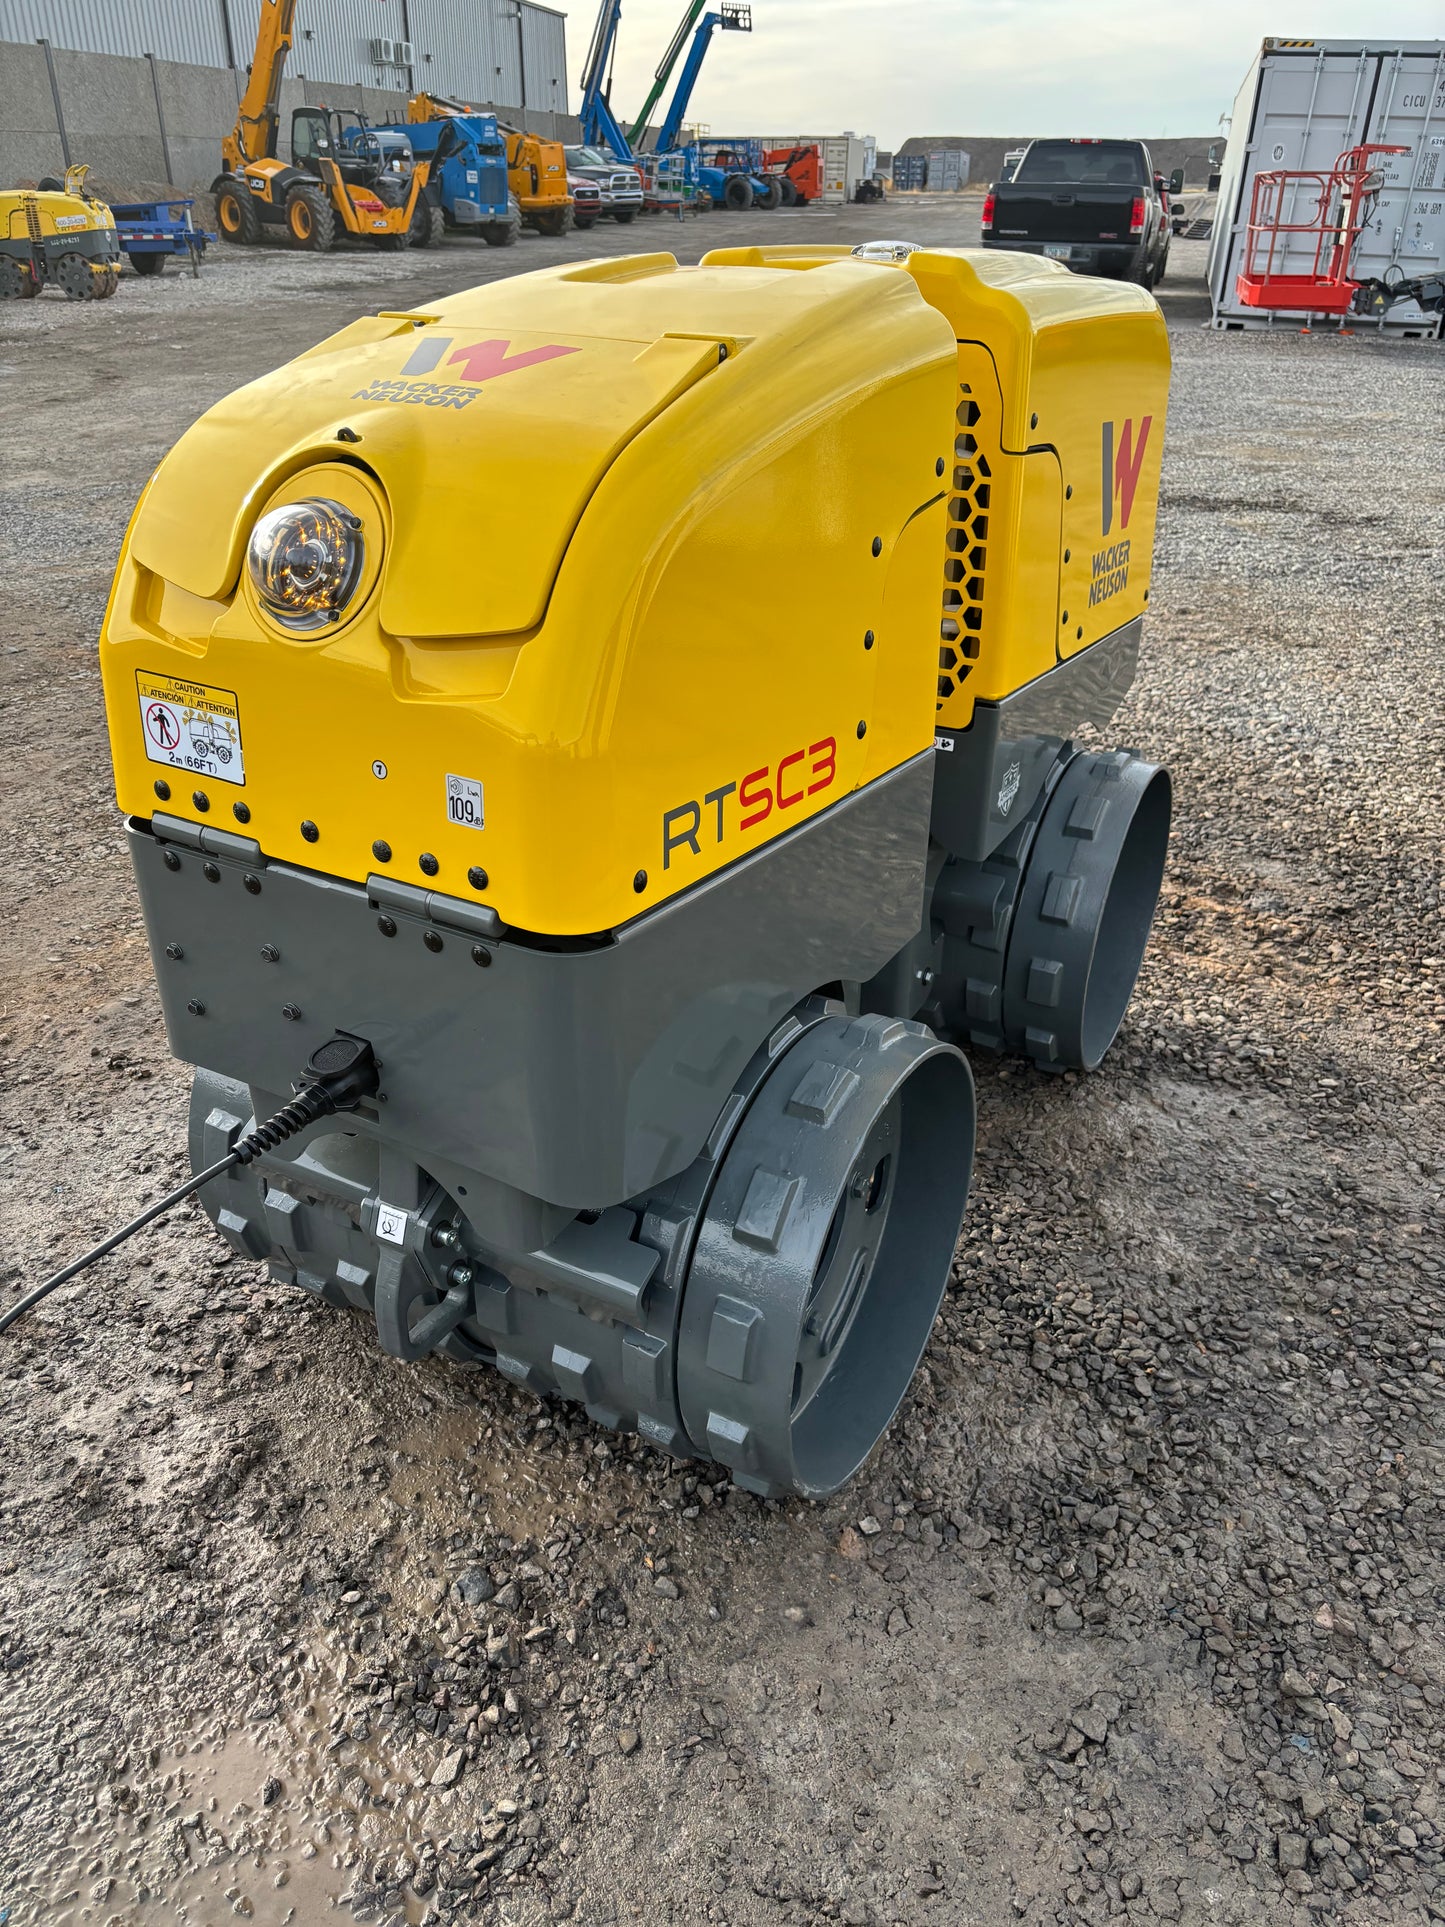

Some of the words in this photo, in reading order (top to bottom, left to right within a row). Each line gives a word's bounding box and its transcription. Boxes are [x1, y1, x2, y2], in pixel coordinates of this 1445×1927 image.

[1403, 94, 1426, 108] CICU
[250, 178, 265, 189] JCB
[372, 220, 388, 228] JCB
[350, 389, 474, 409] NEUSON
[369, 379, 483, 399] WACKER
[1092, 539, 1131, 579] WACKER
[1088, 565, 1129, 608] NEUSON
[174, 681, 206, 697] CAUTION
[150, 688, 184, 704] ATENCIÓN
[196, 700, 236, 716] ATTENTION
[375, 764, 382, 775] 7
[449, 795, 474, 823] 109
[663, 736, 837, 871] RTSC3
